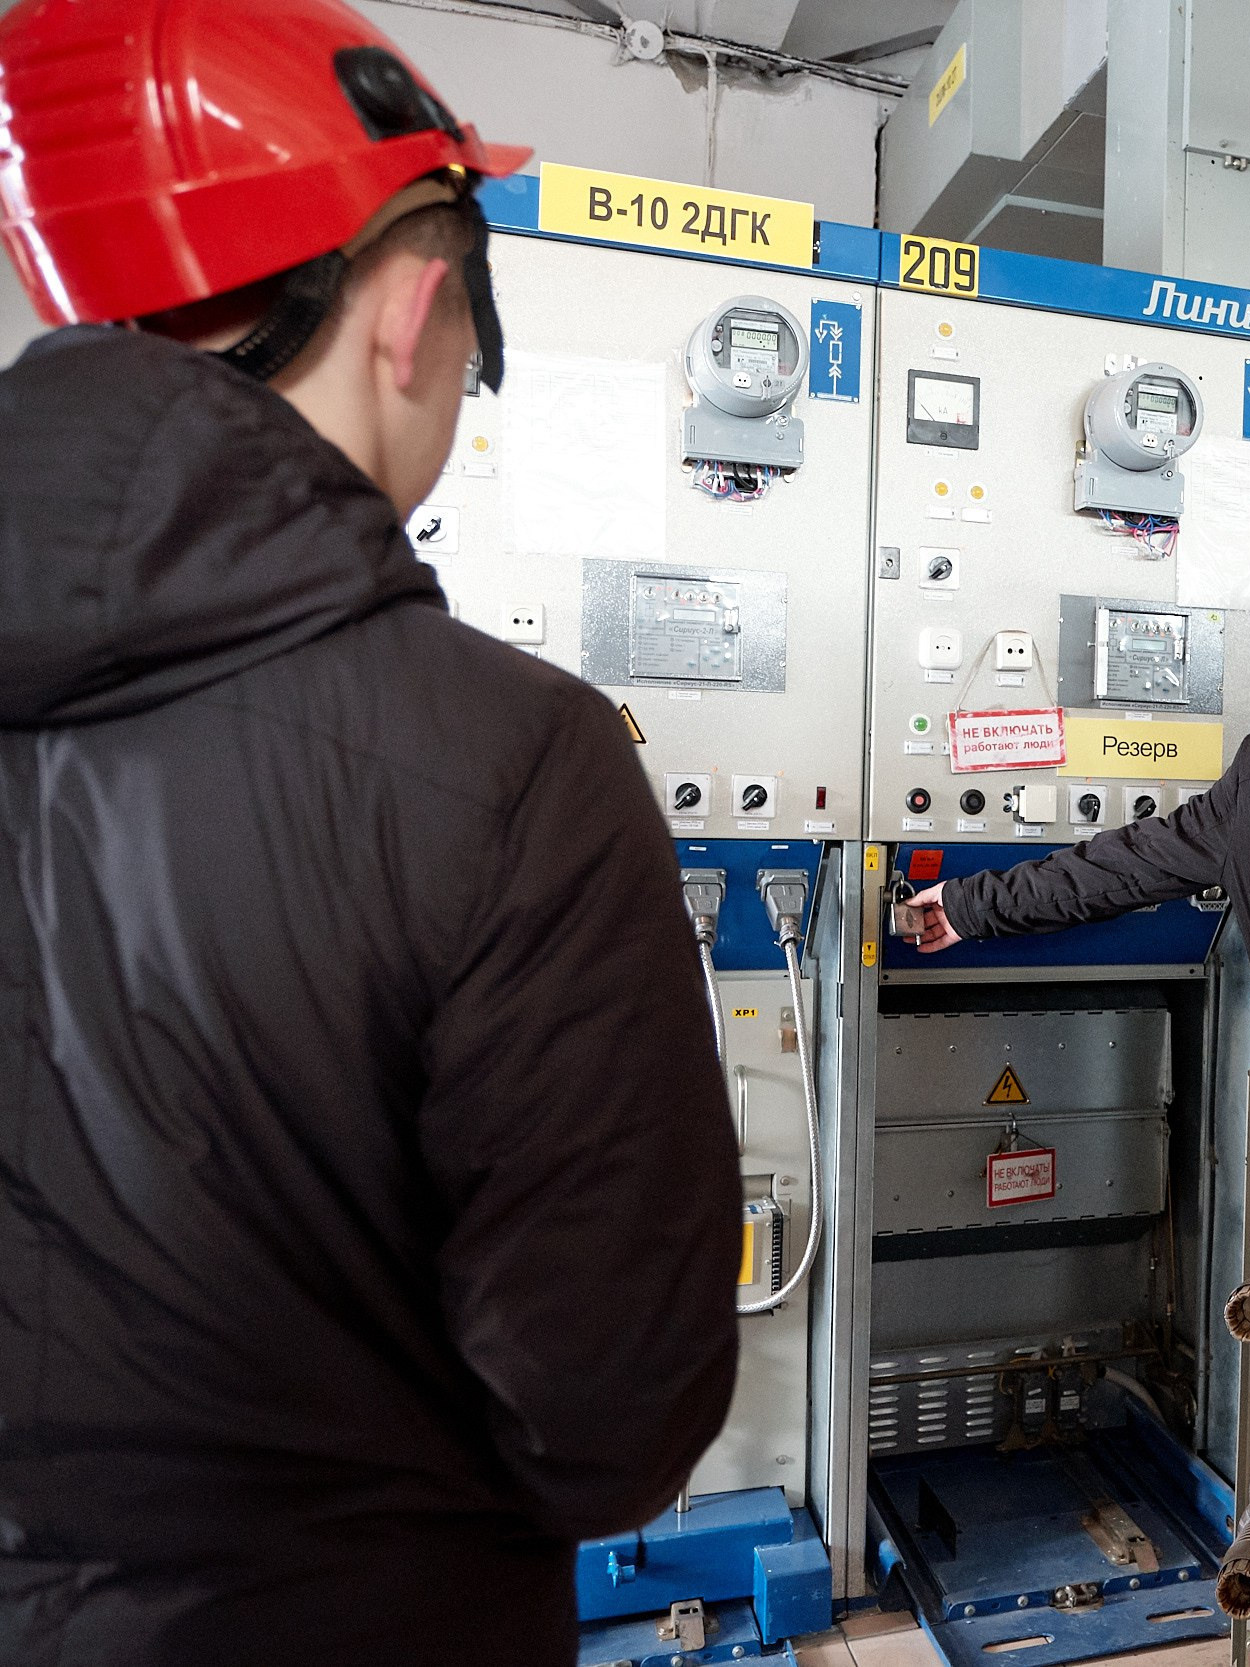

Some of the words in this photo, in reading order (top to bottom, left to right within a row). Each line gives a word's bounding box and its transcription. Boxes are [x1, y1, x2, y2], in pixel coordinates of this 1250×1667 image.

[588, 186, 669, 231] В-10
[681, 201, 772, 247] 2ДГК
[903, 240, 976, 292] 209
[962, 726, 979, 739] НЕ
[983, 723, 1054, 738] ВКЛЮЧАТЬ
[963, 742, 1018, 754] работают
[1022, 739, 1054, 751] люди
[1102, 735, 1178, 762] Резерв
[735, 1009, 755, 1017] XP1
[994, 1168, 1005, 1179] НЕ
